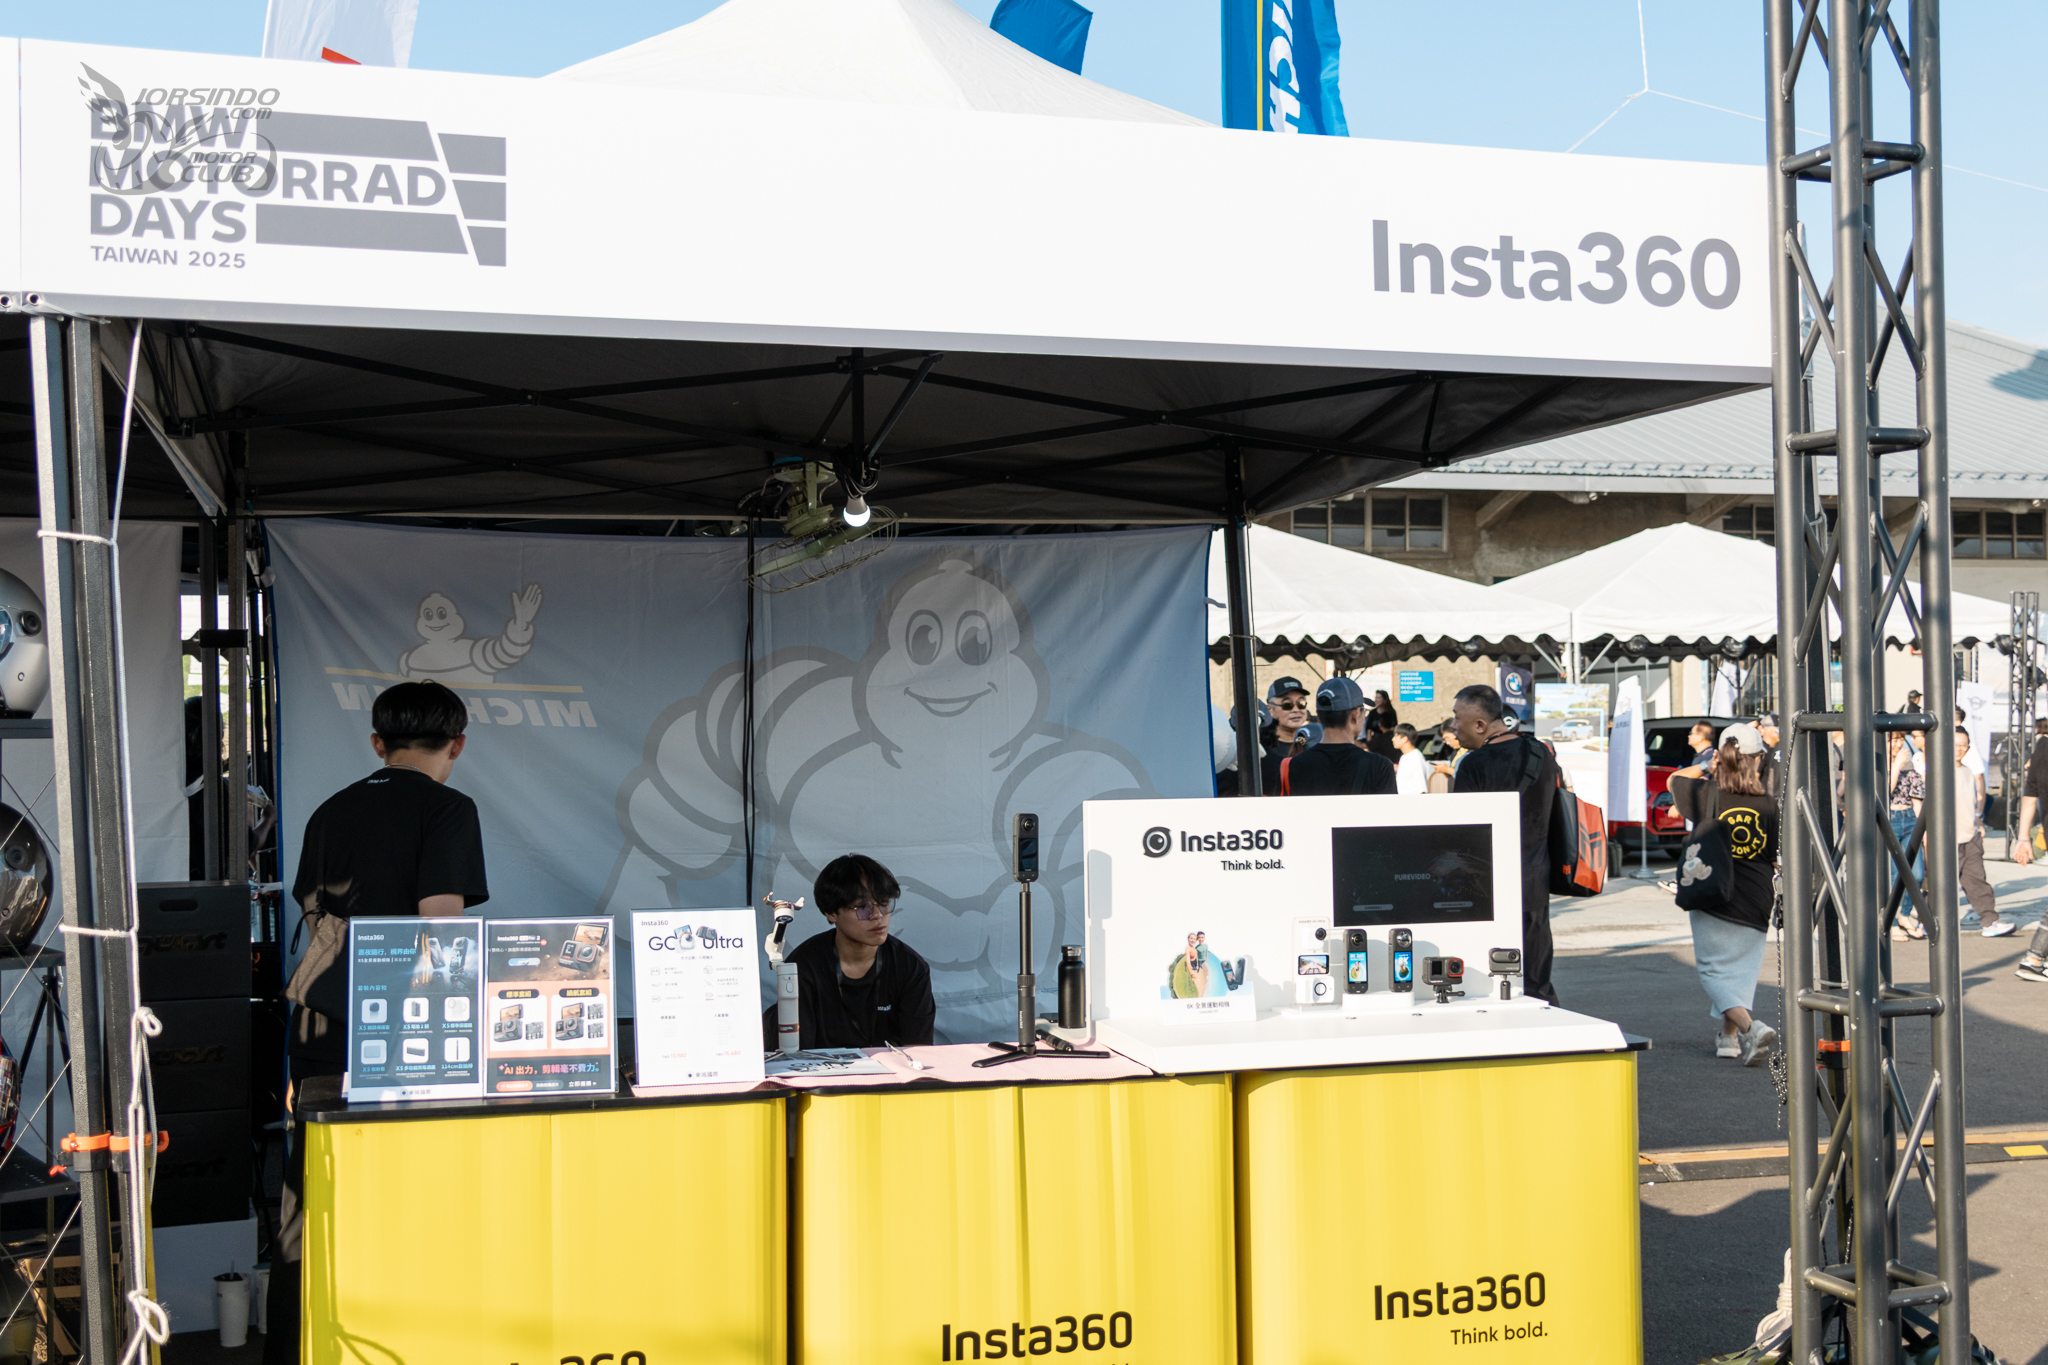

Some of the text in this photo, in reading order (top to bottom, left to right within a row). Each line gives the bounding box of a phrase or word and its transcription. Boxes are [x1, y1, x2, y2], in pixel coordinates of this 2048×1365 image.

[90, 98, 253, 150] BMW
[89, 145, 447, 207] MOTORRAD
[90, 193, 248, 244] DAYS
[90, 246, 247, 269] TAIWAN 2025
[1372, 219, 1741, 310] Insta360
[1180, 829, 1284, 852] Insta360
[1221, 859, 1285, 871] Think bold.
[1195, 1001, 1230, 1009] 全景運動相機
[1374, 1272, 1546, 1321] Insta360
[942, 1310, 1132, 1362] Insta360
[1450, 1321, 1548, 1345] Think bold.
